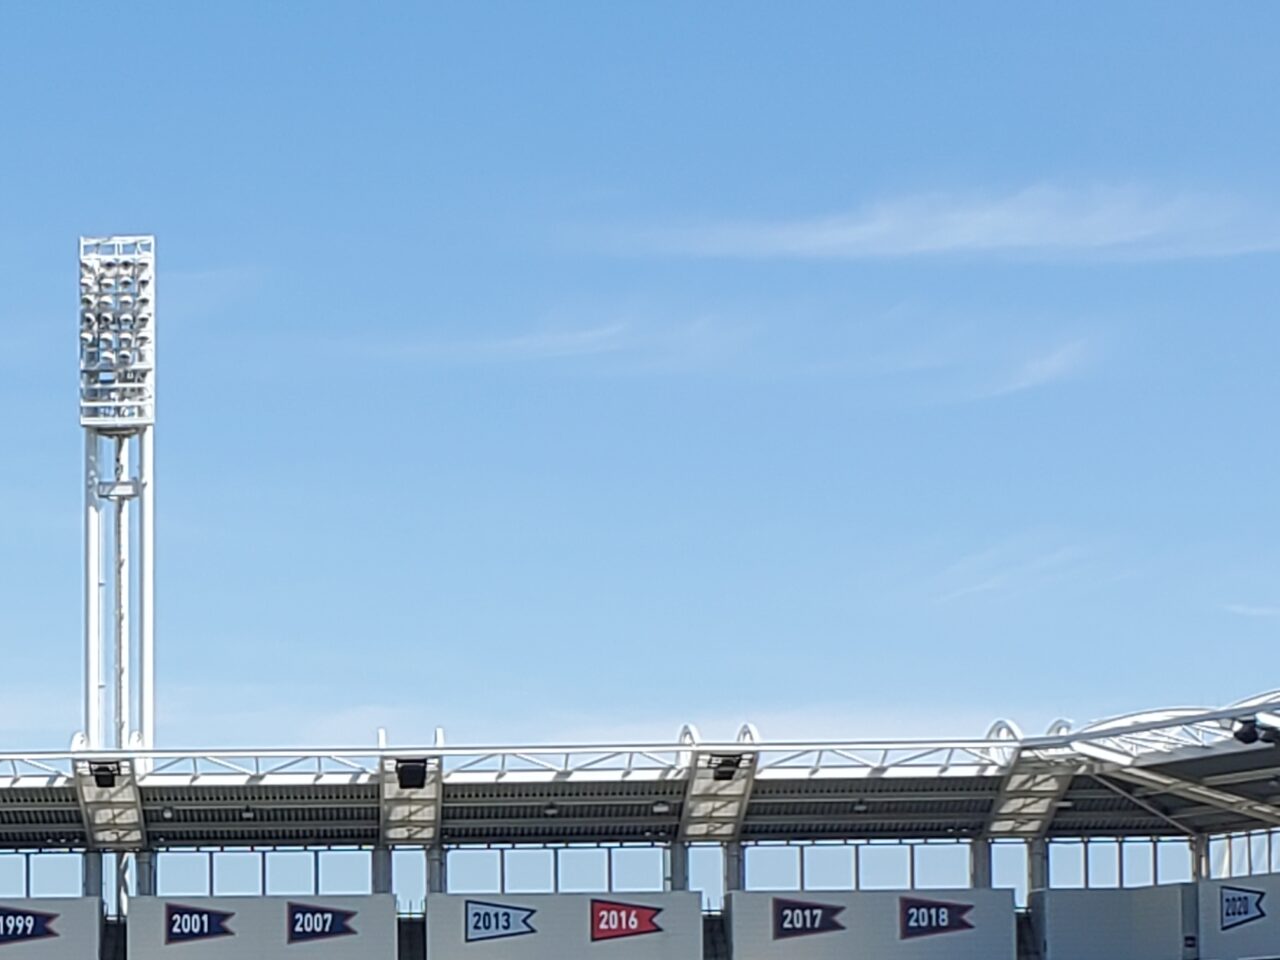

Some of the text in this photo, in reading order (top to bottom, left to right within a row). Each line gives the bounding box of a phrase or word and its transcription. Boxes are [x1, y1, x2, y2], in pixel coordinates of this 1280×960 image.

[171, 913, 209, 933] 2001
[294, 912, 333, 932] 2007
[472, 911, 512, 931] 2013
[598, 910, 639, 930] 2016
[782, 908, 823, 929] 2017
[908, 907, 949, 927] 2018
